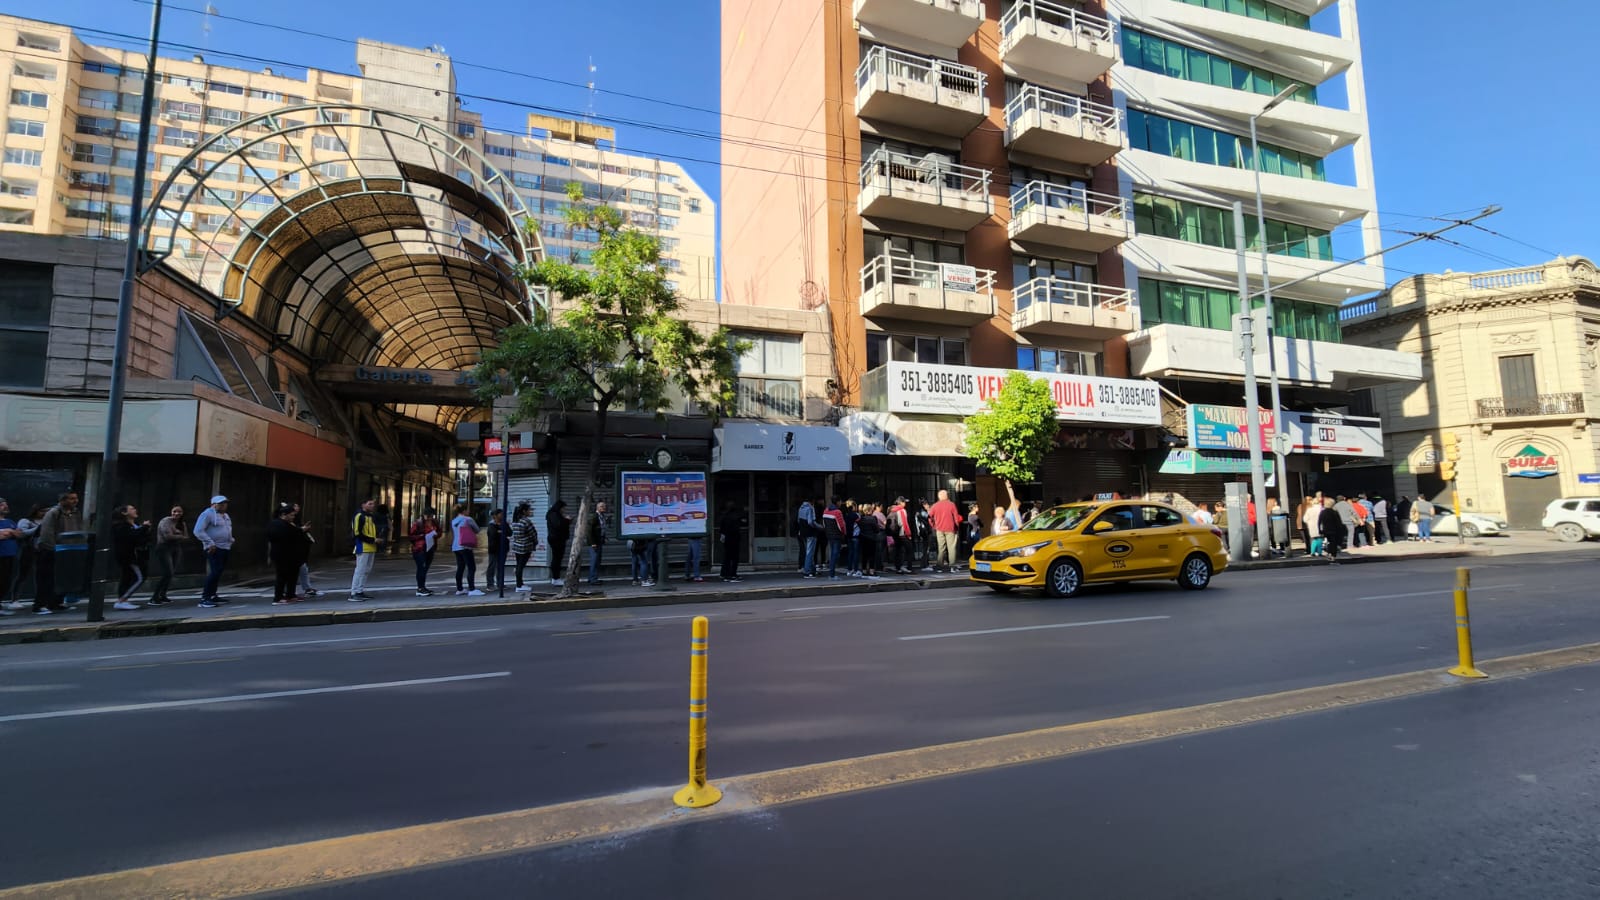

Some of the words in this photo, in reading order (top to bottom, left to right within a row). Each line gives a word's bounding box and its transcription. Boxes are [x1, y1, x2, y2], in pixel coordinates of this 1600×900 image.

[947, 274, 972, 283] VENDE
[901, 370, 973, 394] 351-3895405
[1099, 385, 1156, 407] 351-3895405
[1320, 429, 1335, 441] HD
[1508, 457, 1556, 468] SUIZA
